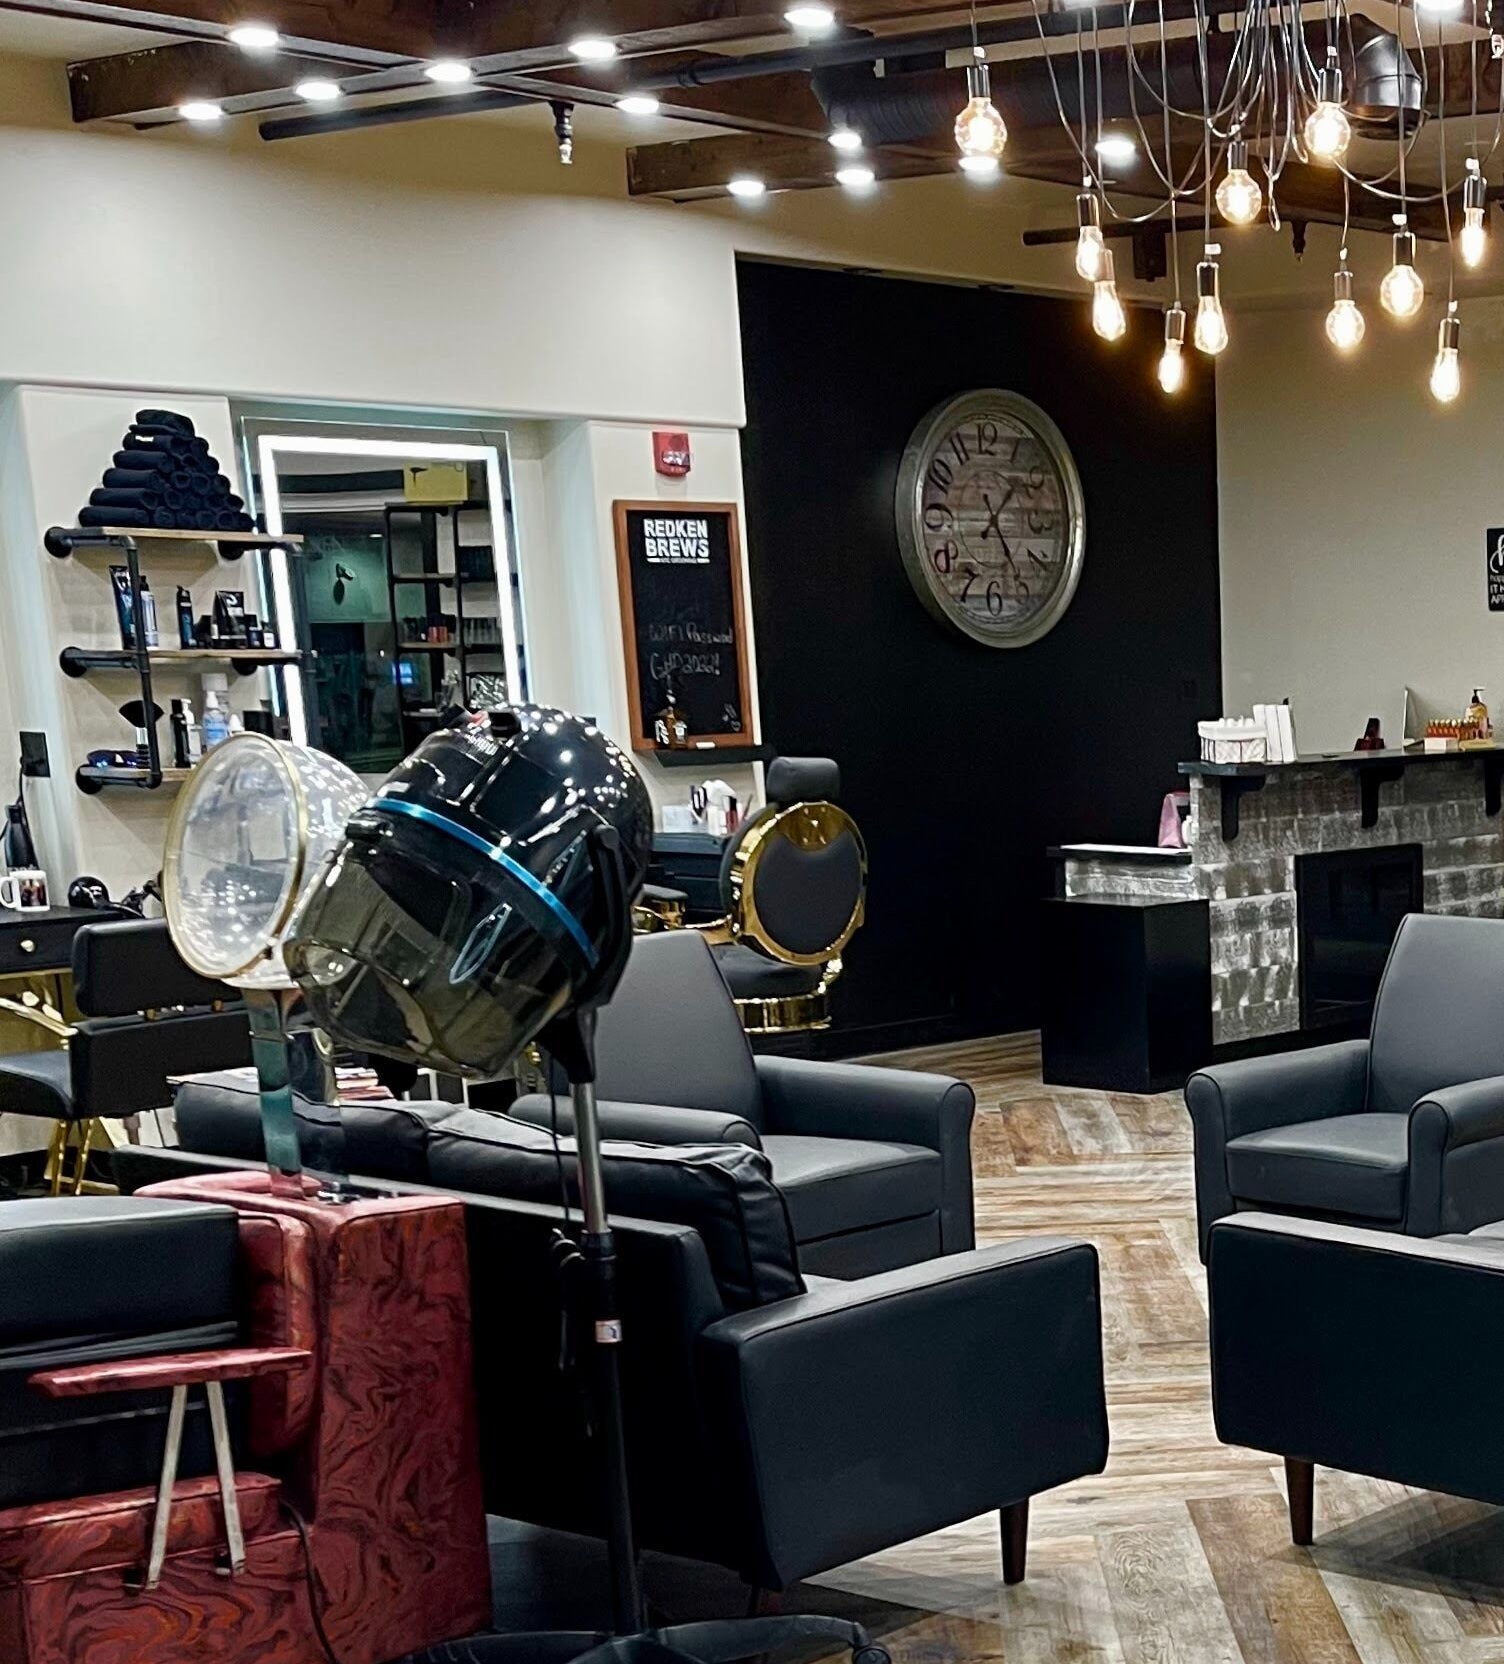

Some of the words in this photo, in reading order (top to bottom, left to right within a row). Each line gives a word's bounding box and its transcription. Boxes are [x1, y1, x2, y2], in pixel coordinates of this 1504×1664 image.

[950, 431, 970, 466] 11
[976, 421, 998, 456] 12
[1010, 439, 1019, 463] 1
[928, 458, 953, 494] 10
[1024, 465, 1045, 498] 2
[643, 518, 708, 538] REDKEN
[924, 503, 954, 531] 9
[1028, 509, 1054, 534] 3
[645, 538, 709, 557] BREWS
[934, 540, 958, 574] 8
[960, 565, 979, 603] 7
[986, 580, 1003, 616] 6
[1490, 584, 1498, 593] IT
